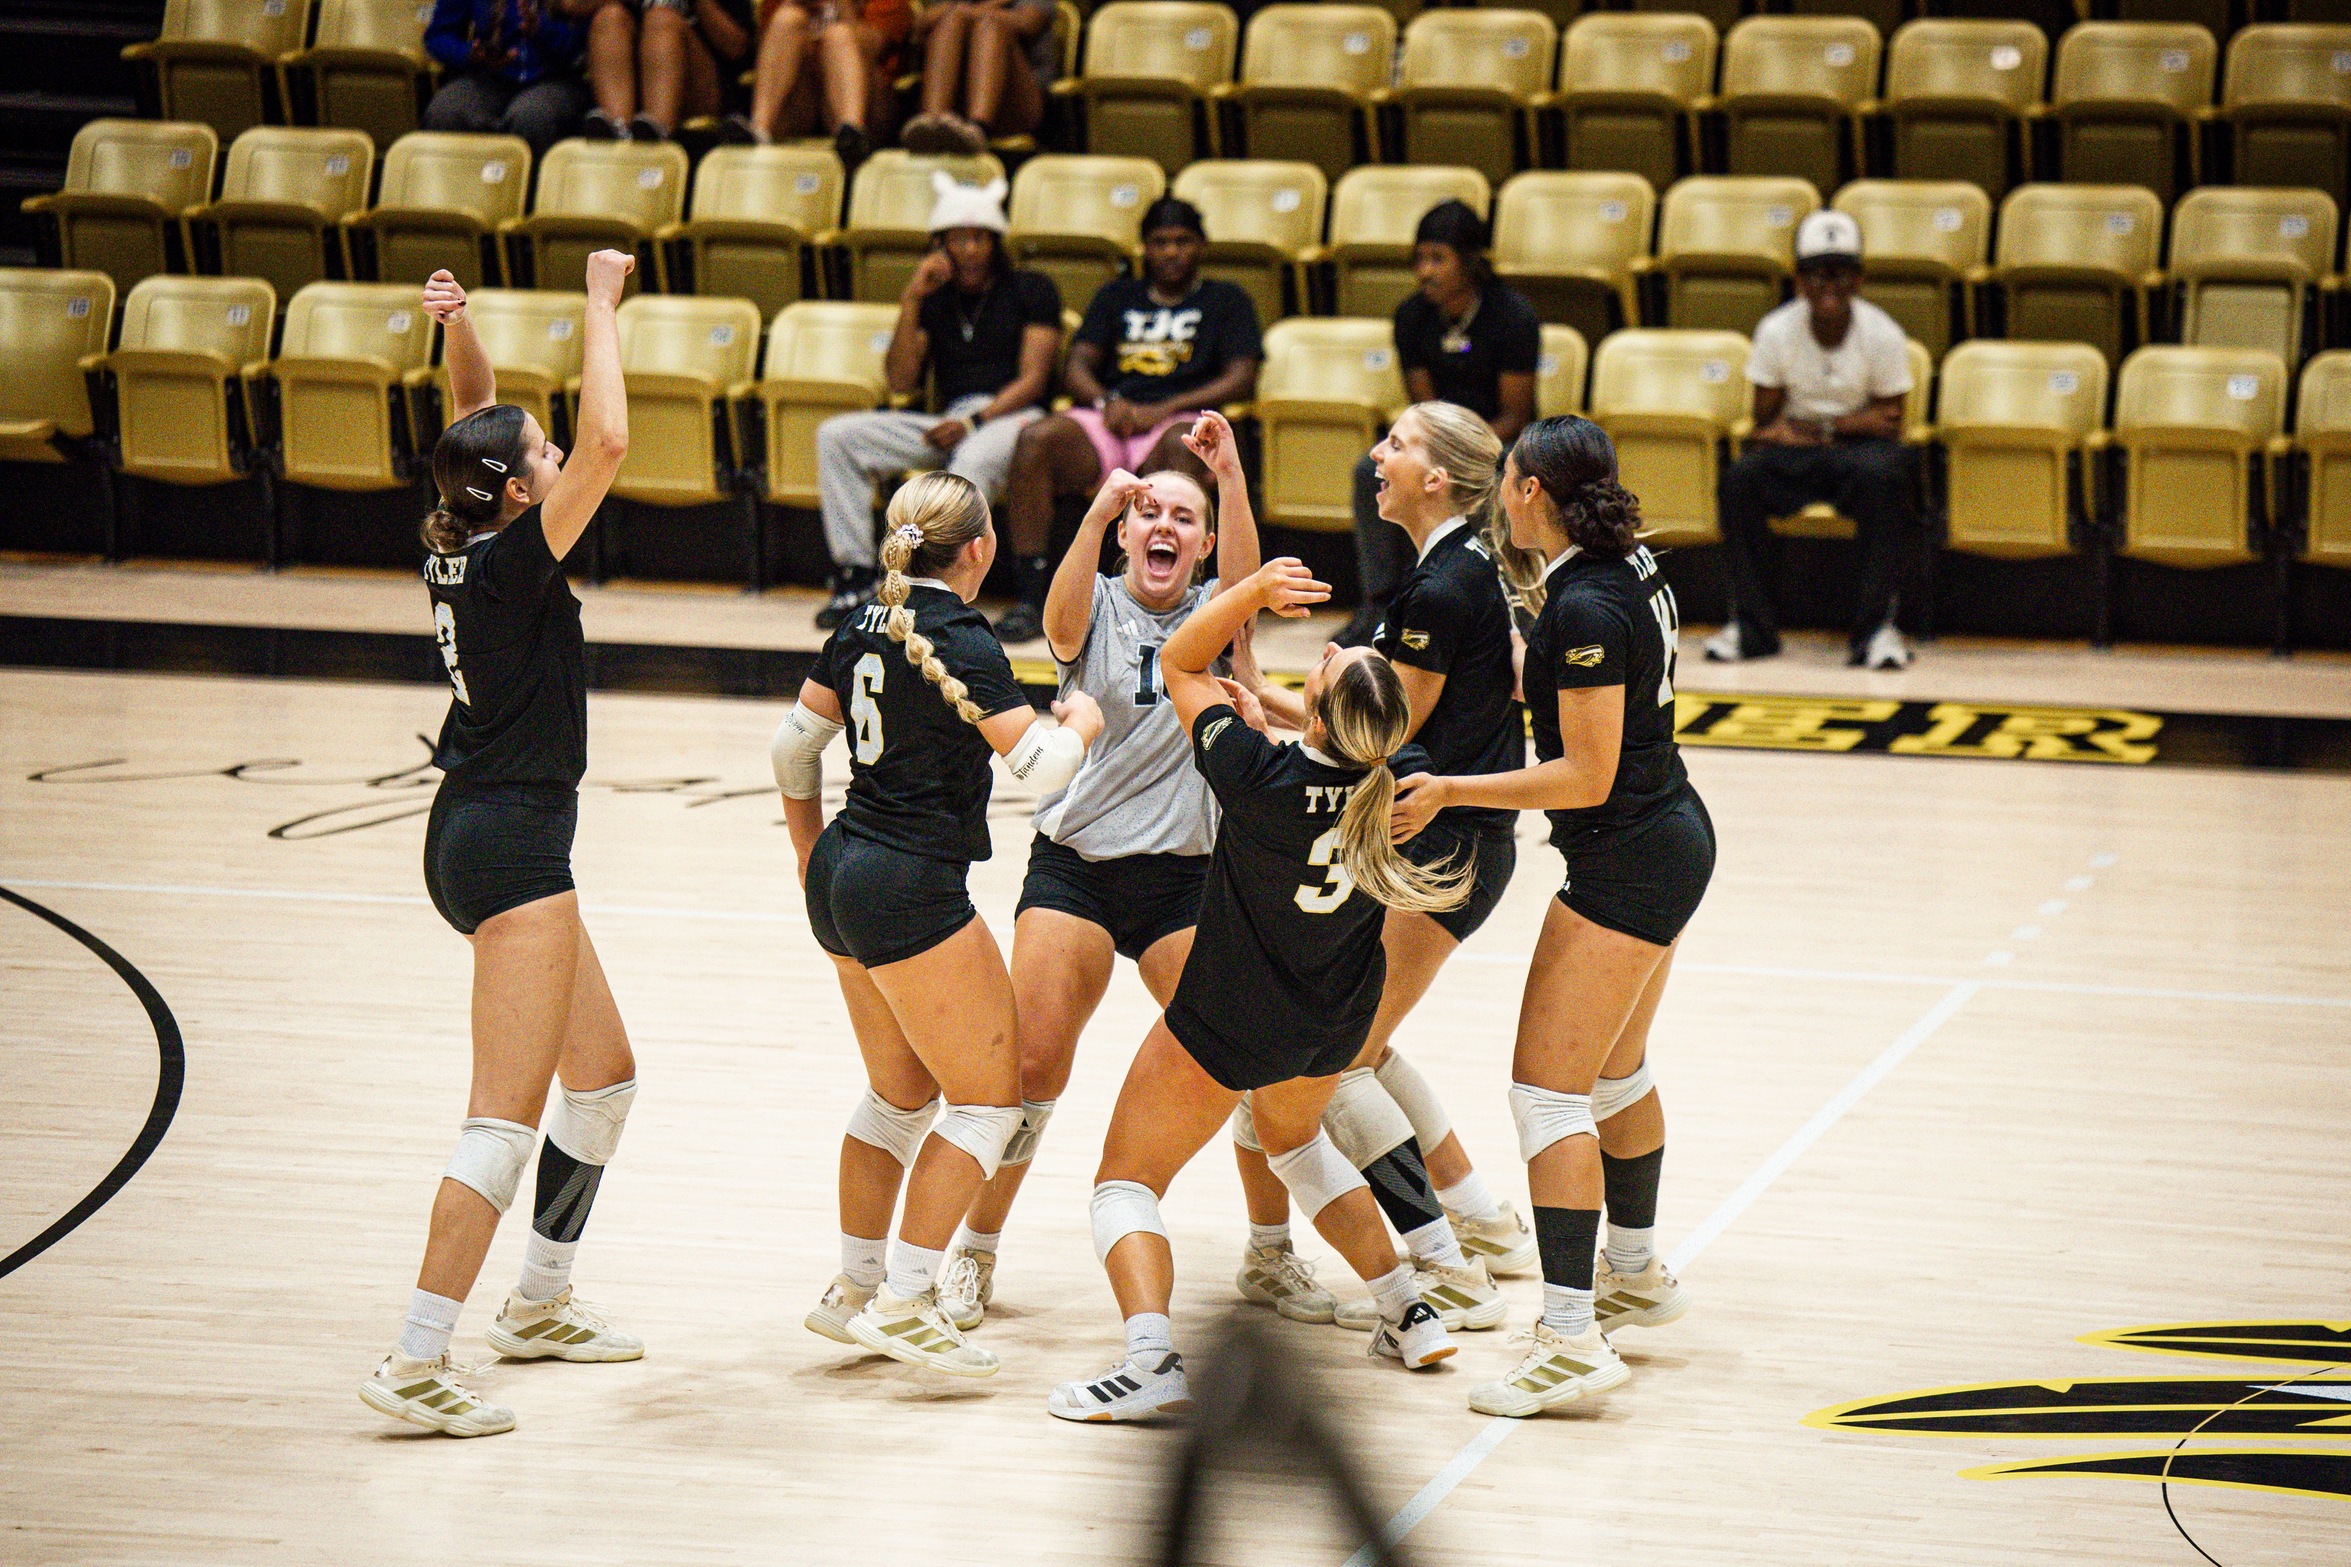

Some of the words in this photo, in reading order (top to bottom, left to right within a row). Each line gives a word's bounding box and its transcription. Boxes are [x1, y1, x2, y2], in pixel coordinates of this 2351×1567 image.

[1122, 308, 1203, 341] TJC
[850, 652, 886, 766] 6
[1133, 643, 1165, 707] 1
[1293, 827, 1358, 914] 3
